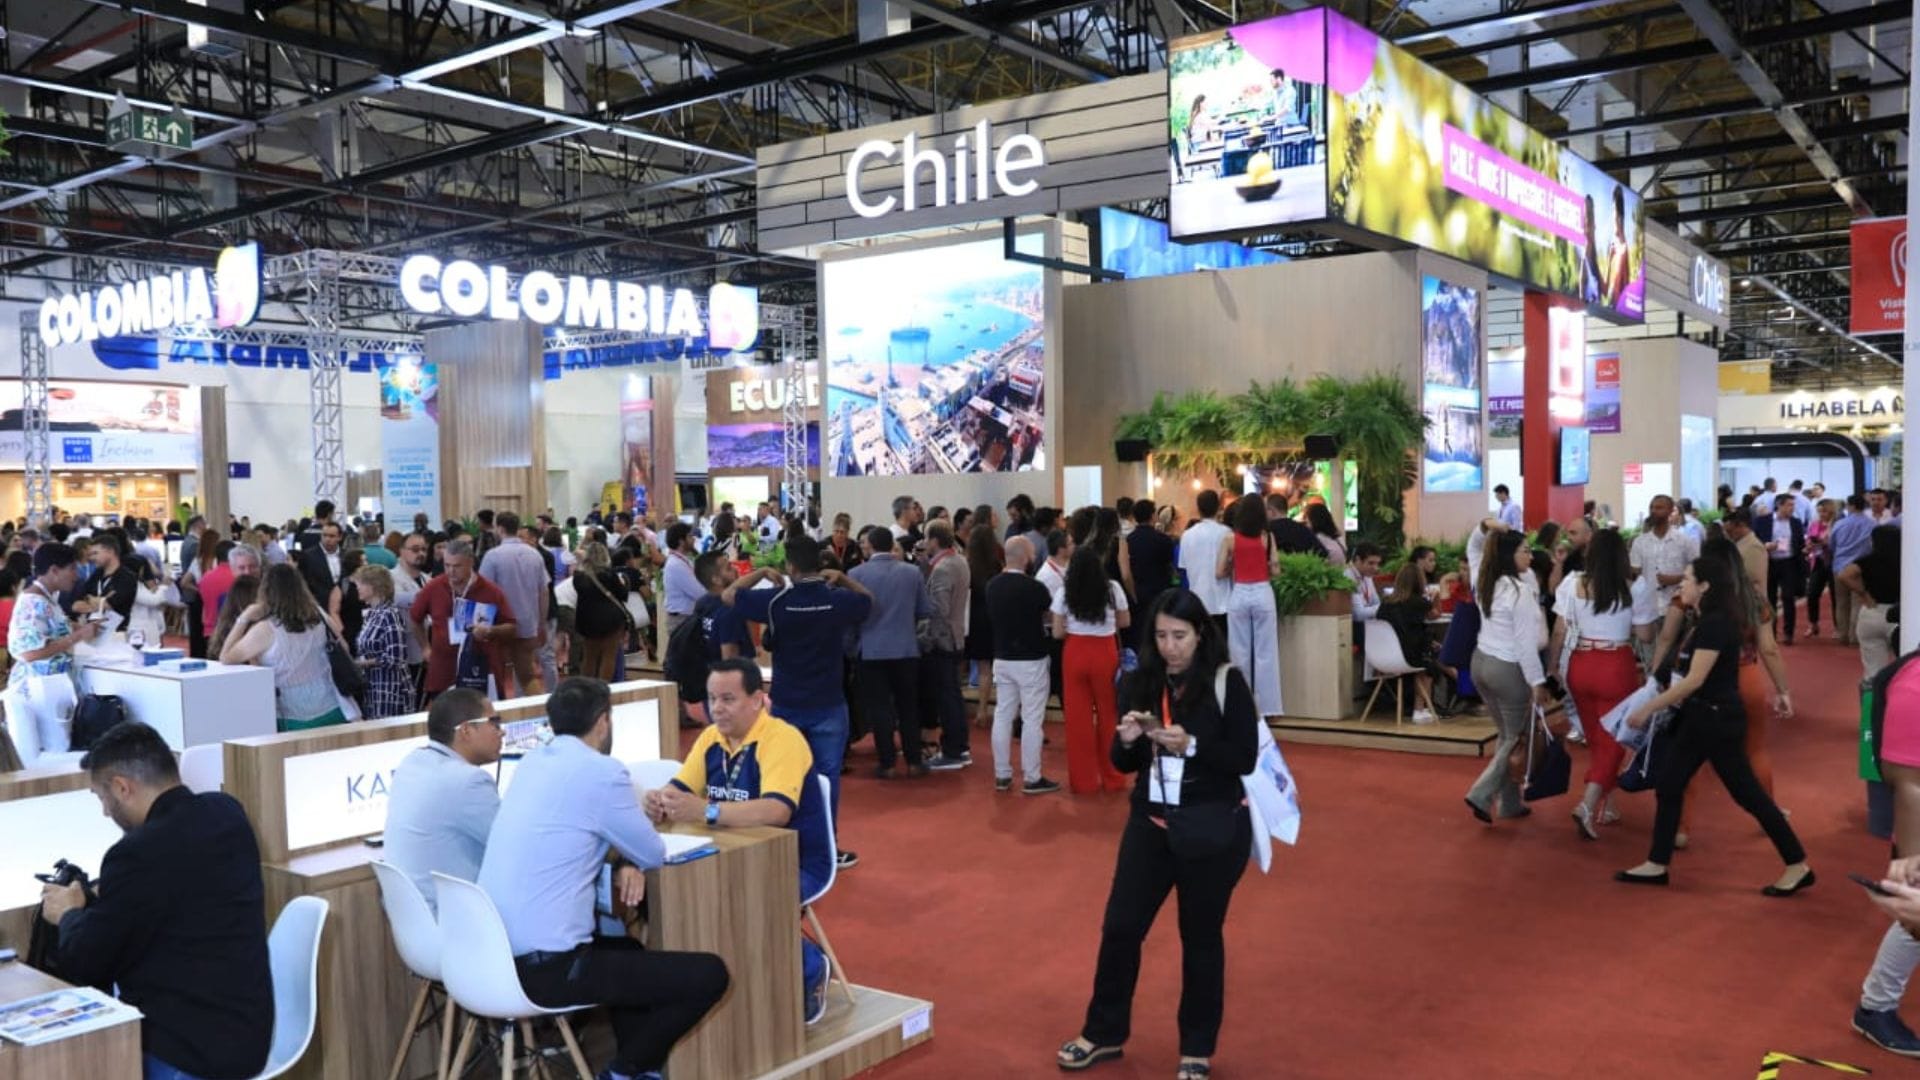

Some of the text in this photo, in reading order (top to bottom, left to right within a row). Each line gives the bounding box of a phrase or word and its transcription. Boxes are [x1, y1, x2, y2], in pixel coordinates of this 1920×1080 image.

[846, 117, 1045, 219] Chile
[39, 266, 214, 348] COLOMBIA
[399, 254, 704, 338] COLOMBIA
[1692, 255, 1725, 315] Chile
[1780, 398, 1886, 420] ILHABELA
[347, 769, 397, 804] KA
